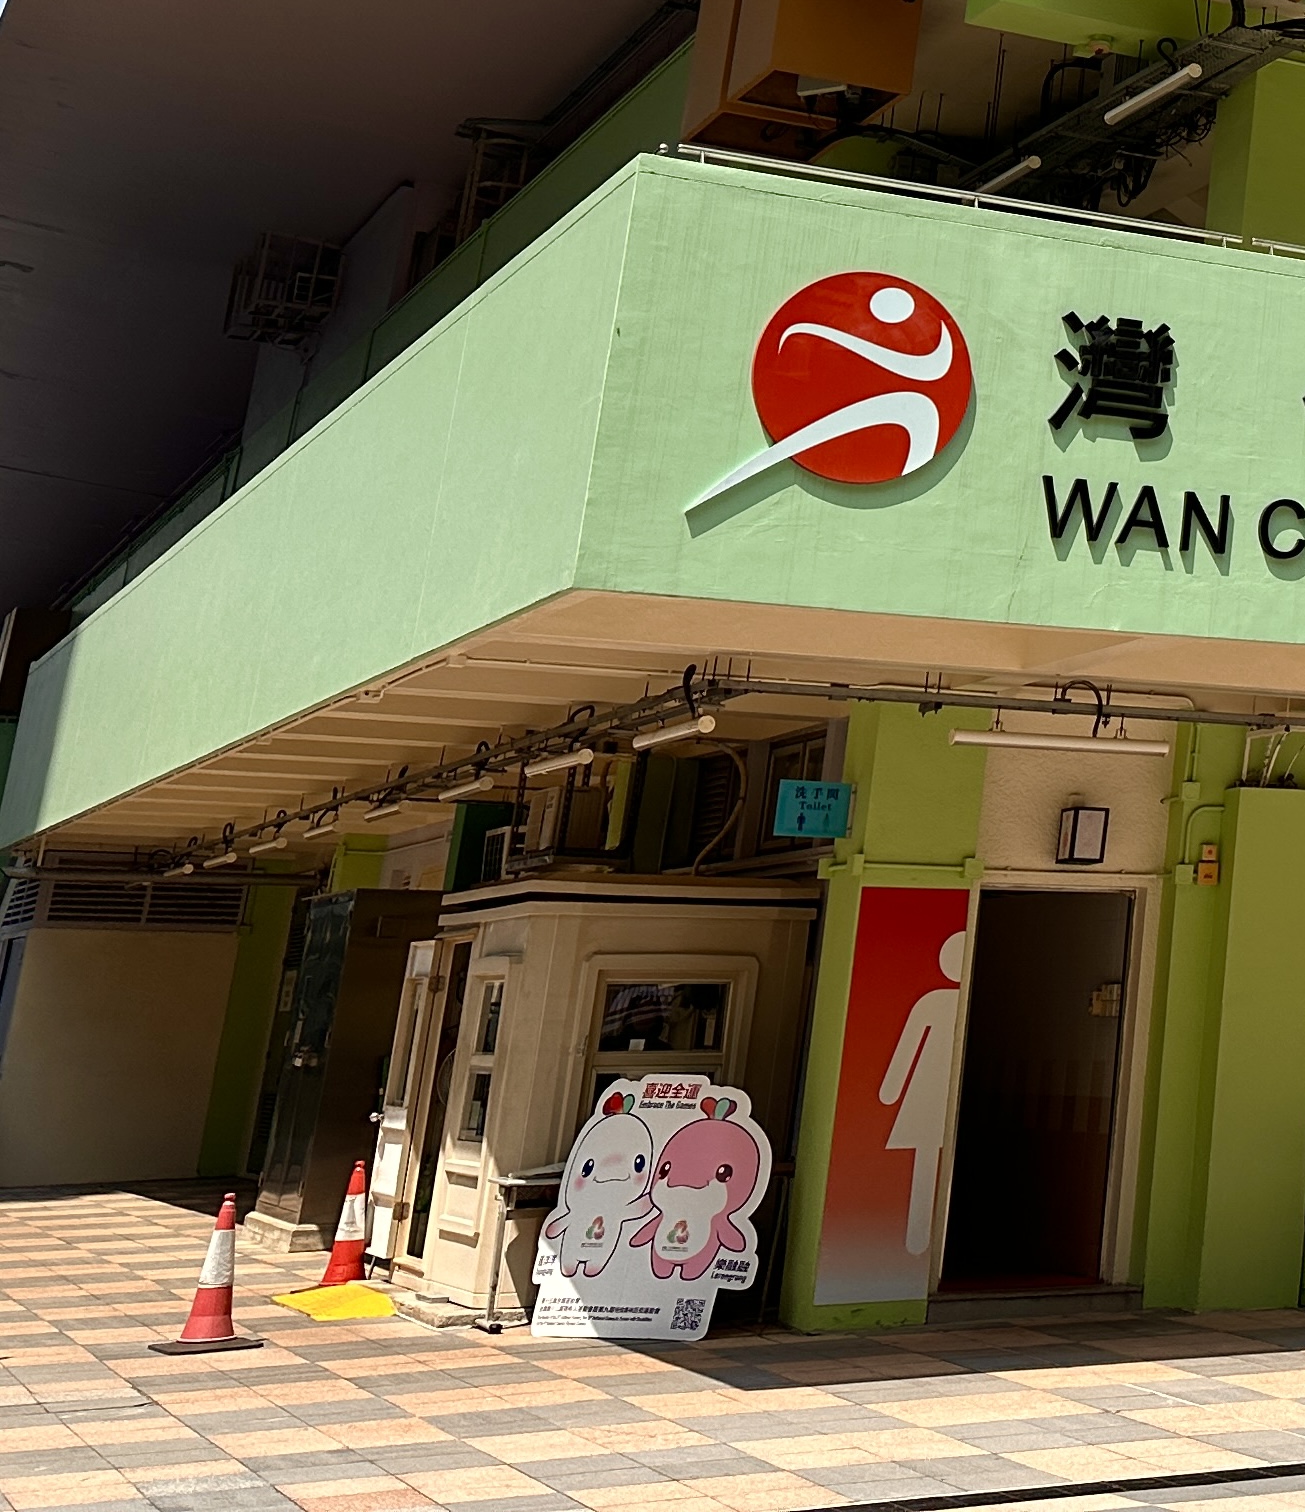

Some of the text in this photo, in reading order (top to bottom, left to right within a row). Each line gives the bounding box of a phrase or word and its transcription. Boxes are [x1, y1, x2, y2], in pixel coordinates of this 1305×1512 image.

[1043, 474, 1231, 556] WAN
[795, 786, 839, 800] 洗手間
[799, 801, 833, 811] Toilet
[642, 1082, 702, 1099] 喜迎全運
